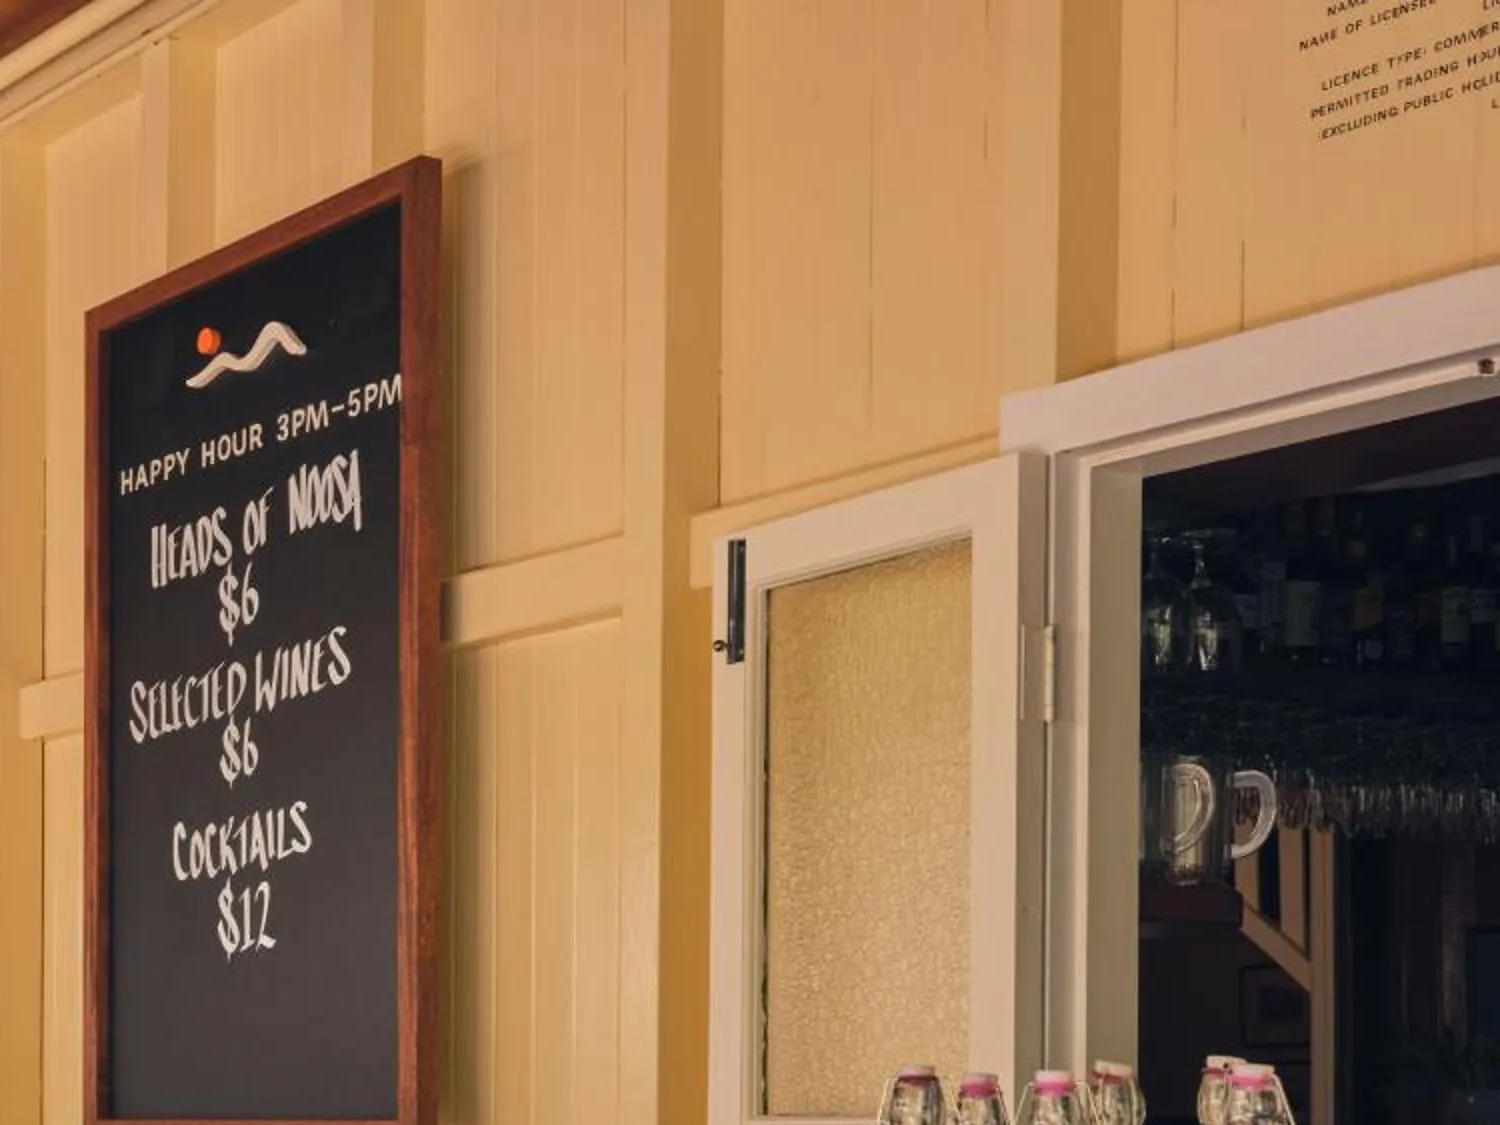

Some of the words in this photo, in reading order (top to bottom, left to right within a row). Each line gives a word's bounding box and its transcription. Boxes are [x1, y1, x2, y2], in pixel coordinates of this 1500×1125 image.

[1299, 29, 1338, 51] NAME
[1345, 19, 1363, 35] OF
[1310, 84, 1389, 119] PERMITTED
[1397, 61, 1459, 90] TRADING
[1321, 63, 1379, 91] LICENCE
[1403, 87, 1454, 112] PUBLIC
[120, 447, 191, 496] HAPPY
[201, 423, 263, 468] HOUR
[150, 506, 233, 589] HEADS
[242, 486, 274, 555] OF
[288, 448, 362, 536] NOOSA
[218, 560, 260, 647] $6
[129, 661, 247, 744] SELECTED
[255, 626, 351, 713] WINES
[219, 715, 260, 789] $6
[172, 801, 312, 881] COCKTAILS
[217, 876, 276, 963] $12
